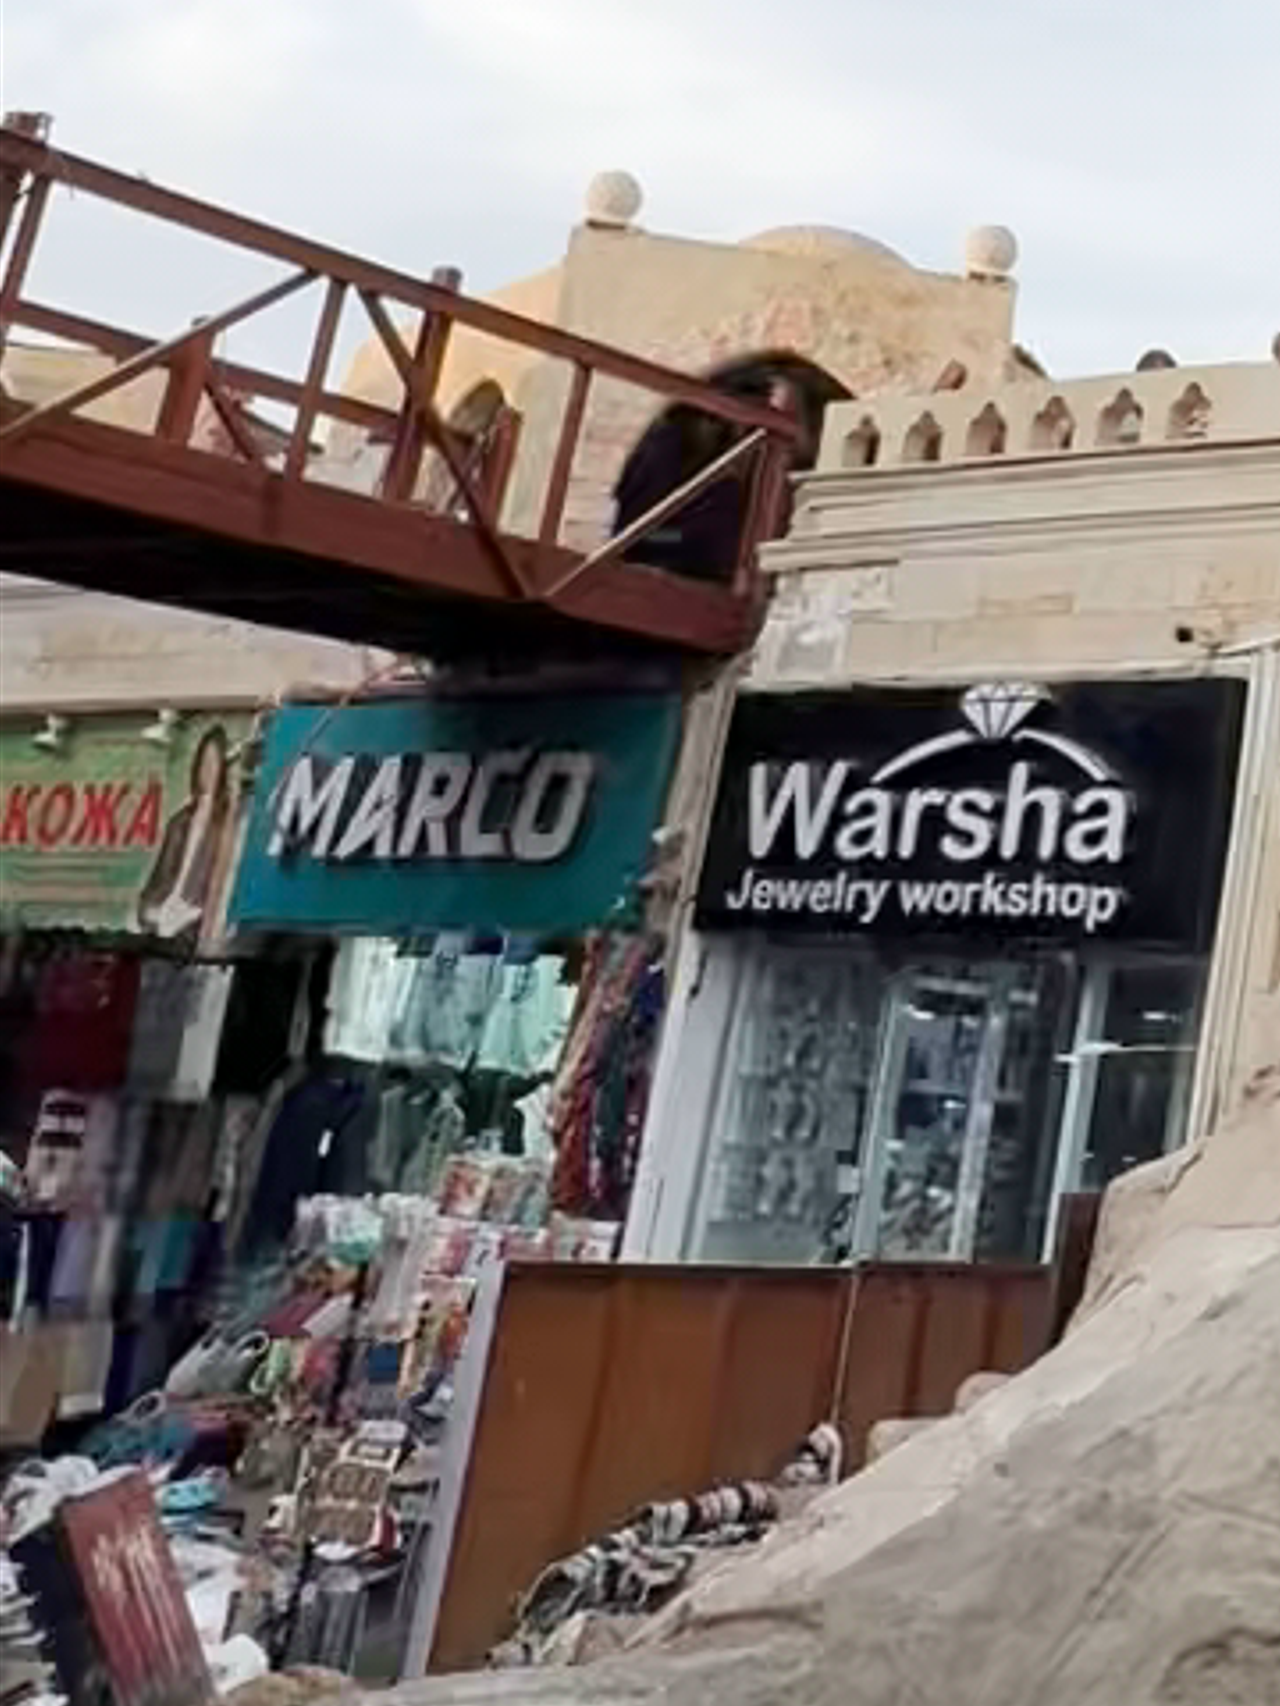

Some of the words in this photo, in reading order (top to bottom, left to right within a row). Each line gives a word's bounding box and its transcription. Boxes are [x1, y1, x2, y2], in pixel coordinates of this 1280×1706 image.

[0, 782, 163, 846] КОЖА
[267, 751, 594, 862] MARCO
[749, 761, 1127, 863] Warsha
[726, 869, 890, 924] Jewelry
[902, 872, 1118, 932] workshop
